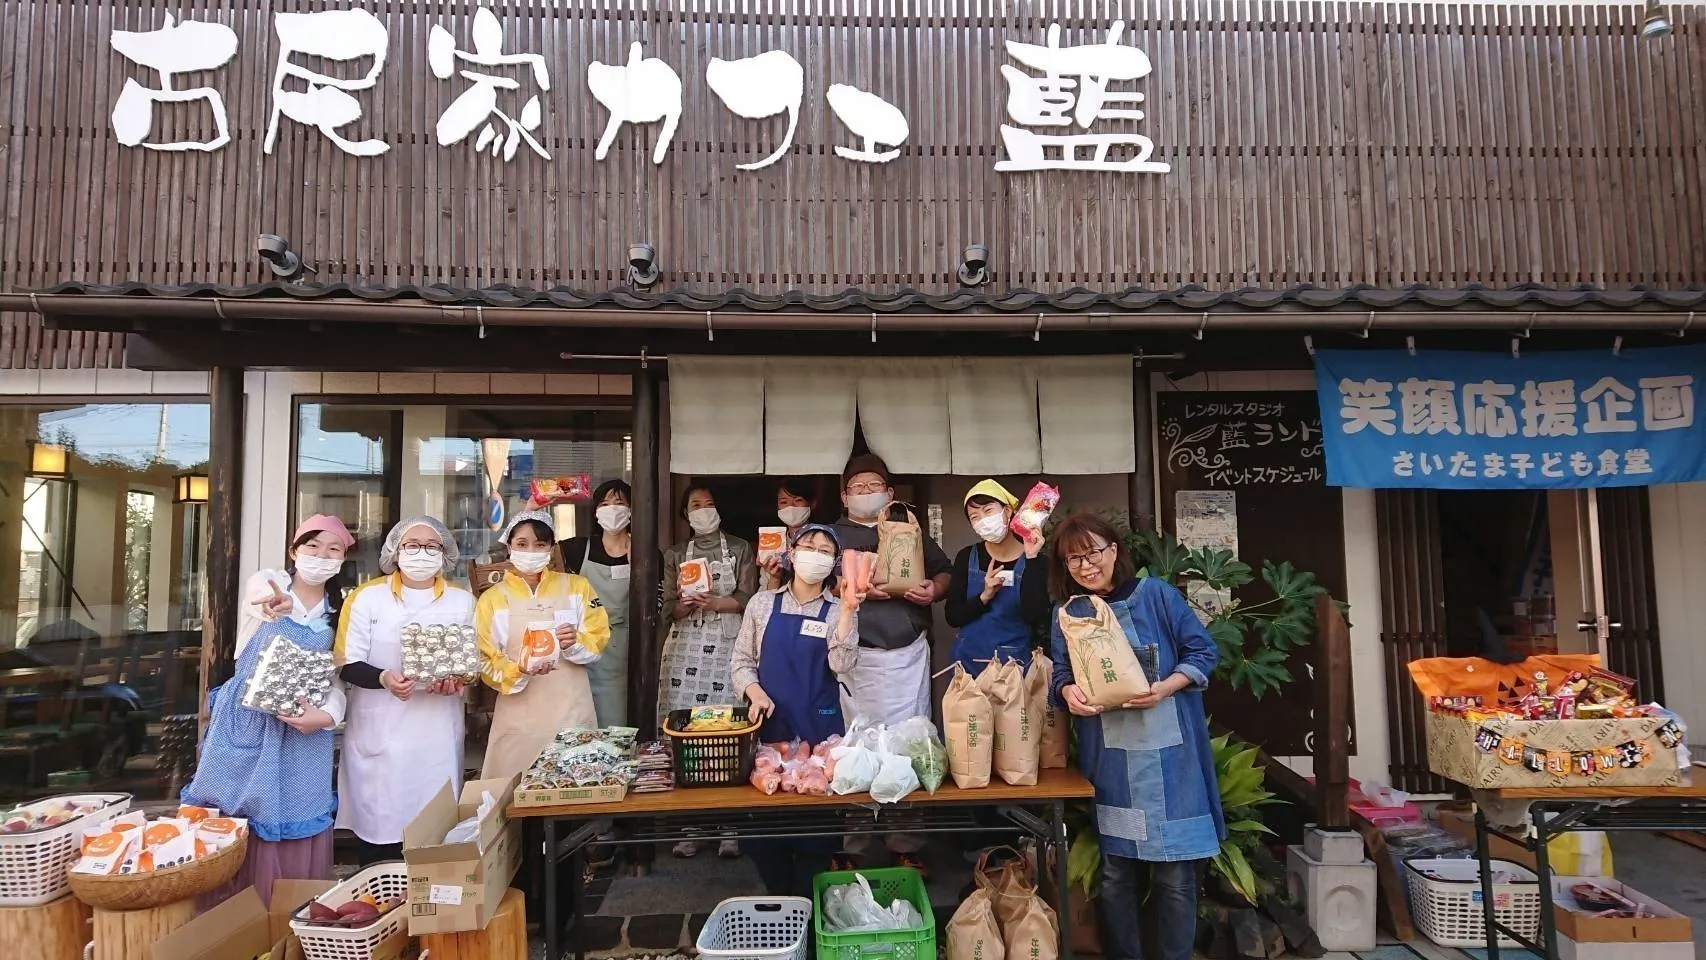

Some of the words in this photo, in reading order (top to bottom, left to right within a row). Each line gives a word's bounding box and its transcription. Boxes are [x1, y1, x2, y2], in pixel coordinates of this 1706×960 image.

[994, 20, 1171, 173] 藍
[1186, 403, 1286, 418] レンタルスタジオ
[1338, 375, 1695, 438] 笑顔応援企画
[1218, 421, 1322, 450] 藍ランド
[1204, 466, 1322, 487] イベントスケジュール
[1392, 448, 1653, 479] さいたま子ども食堂
[900, 558, 911, 579] お米
[1100, 657, 1118, 684] お米
